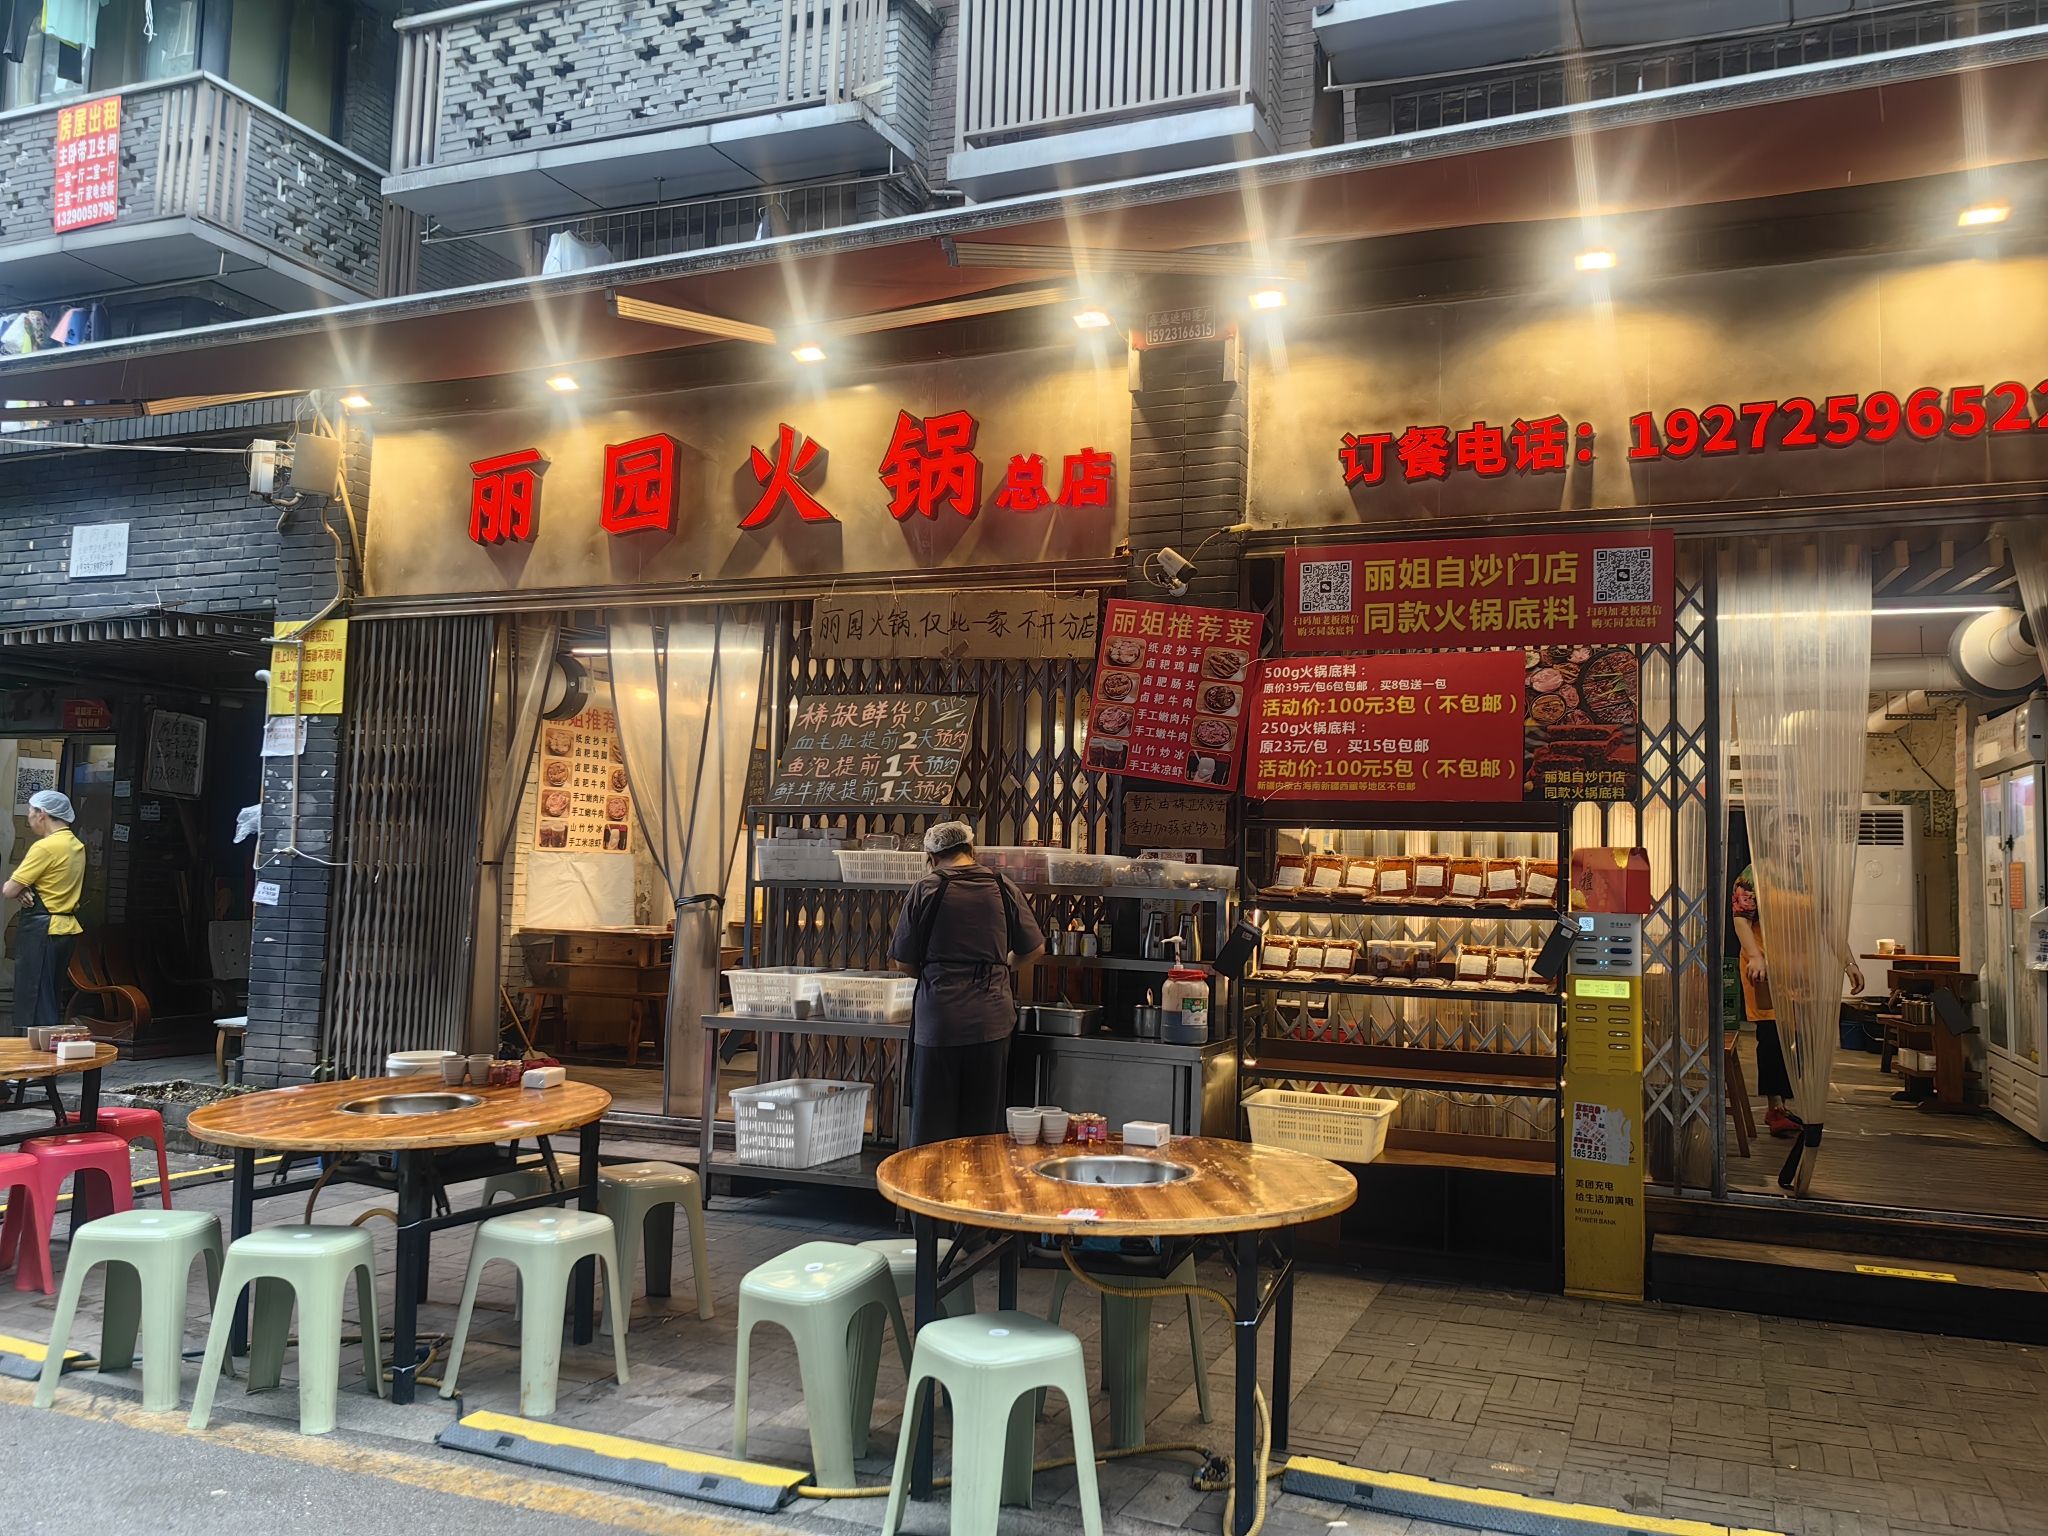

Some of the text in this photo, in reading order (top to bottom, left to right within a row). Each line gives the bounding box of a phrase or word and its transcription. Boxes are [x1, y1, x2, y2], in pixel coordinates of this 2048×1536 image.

[60, 101, 117, 141] 房屋出租
[58, 134, 116, 167] 主卧带卫生间
[58, 161, 115, 187] 一室一厅 二室一厅
[57, 188, 84, 207] 三室一厅
[57, 201, 115, 226] 13290059796
[1148, 323, 1212, 342] 15923166315
[1338, 415, 1596, 484] 订餐电话：
[1364, 551, 1579, 592] 丽姐自炒门店
[1364, 595, 1579, 635] 同款火锅底料
[1586, 604, 1663, 617] 扫码加老板微信
[1112, 607, 1254, 646] 丽姐推荐菜
[1293, 614, 1360, 626] 扫码加老板微信
[1591, 616, 1657, 629] 购买同款底料
[1297, 625, 1354, 637] 购买同款底料
[274, 647, 343, 663] 晚上10后请不要吵闹
[1148, 642, 1202, 657] 纸皮抄手
[1264, 664, 1367, 680] 500g火锅底料：
[1143, 675, 1196, 691] 卤肥肠头
[549, 708, 616, 733] 姐推荐
[798, 700, 928, 733] 稀缺鲜货！
[1137, 709, 1191, 726] 手工嫩肉片
[791, 728, 969, 752] 血毛肚提前2天预约
[1135, 726, 1188, 743] 手工嫩牛肉
[1132, 743, 1185, 761] 山竹炒冰
[781, 753, 959, 778] 鱼泡提前1天预约
[1129, 760, 1184, 778] 手工米凉虾
[1544, 771, 1626, 785] 丽姐自炒门店
[771, 779, 954, 805] 鲜牛鞭提前1天预约
[1544, 785, 1626, 800] 同款火锅底料
[1576, 1179, 1614, 1191] 美团充电
[1576, 1193, 1634, 1207] 给生活加满电
[1575, 1207, 1604, 1216] MEITUAN
[1575, 1216, 1616, 1225] POWER BANK
